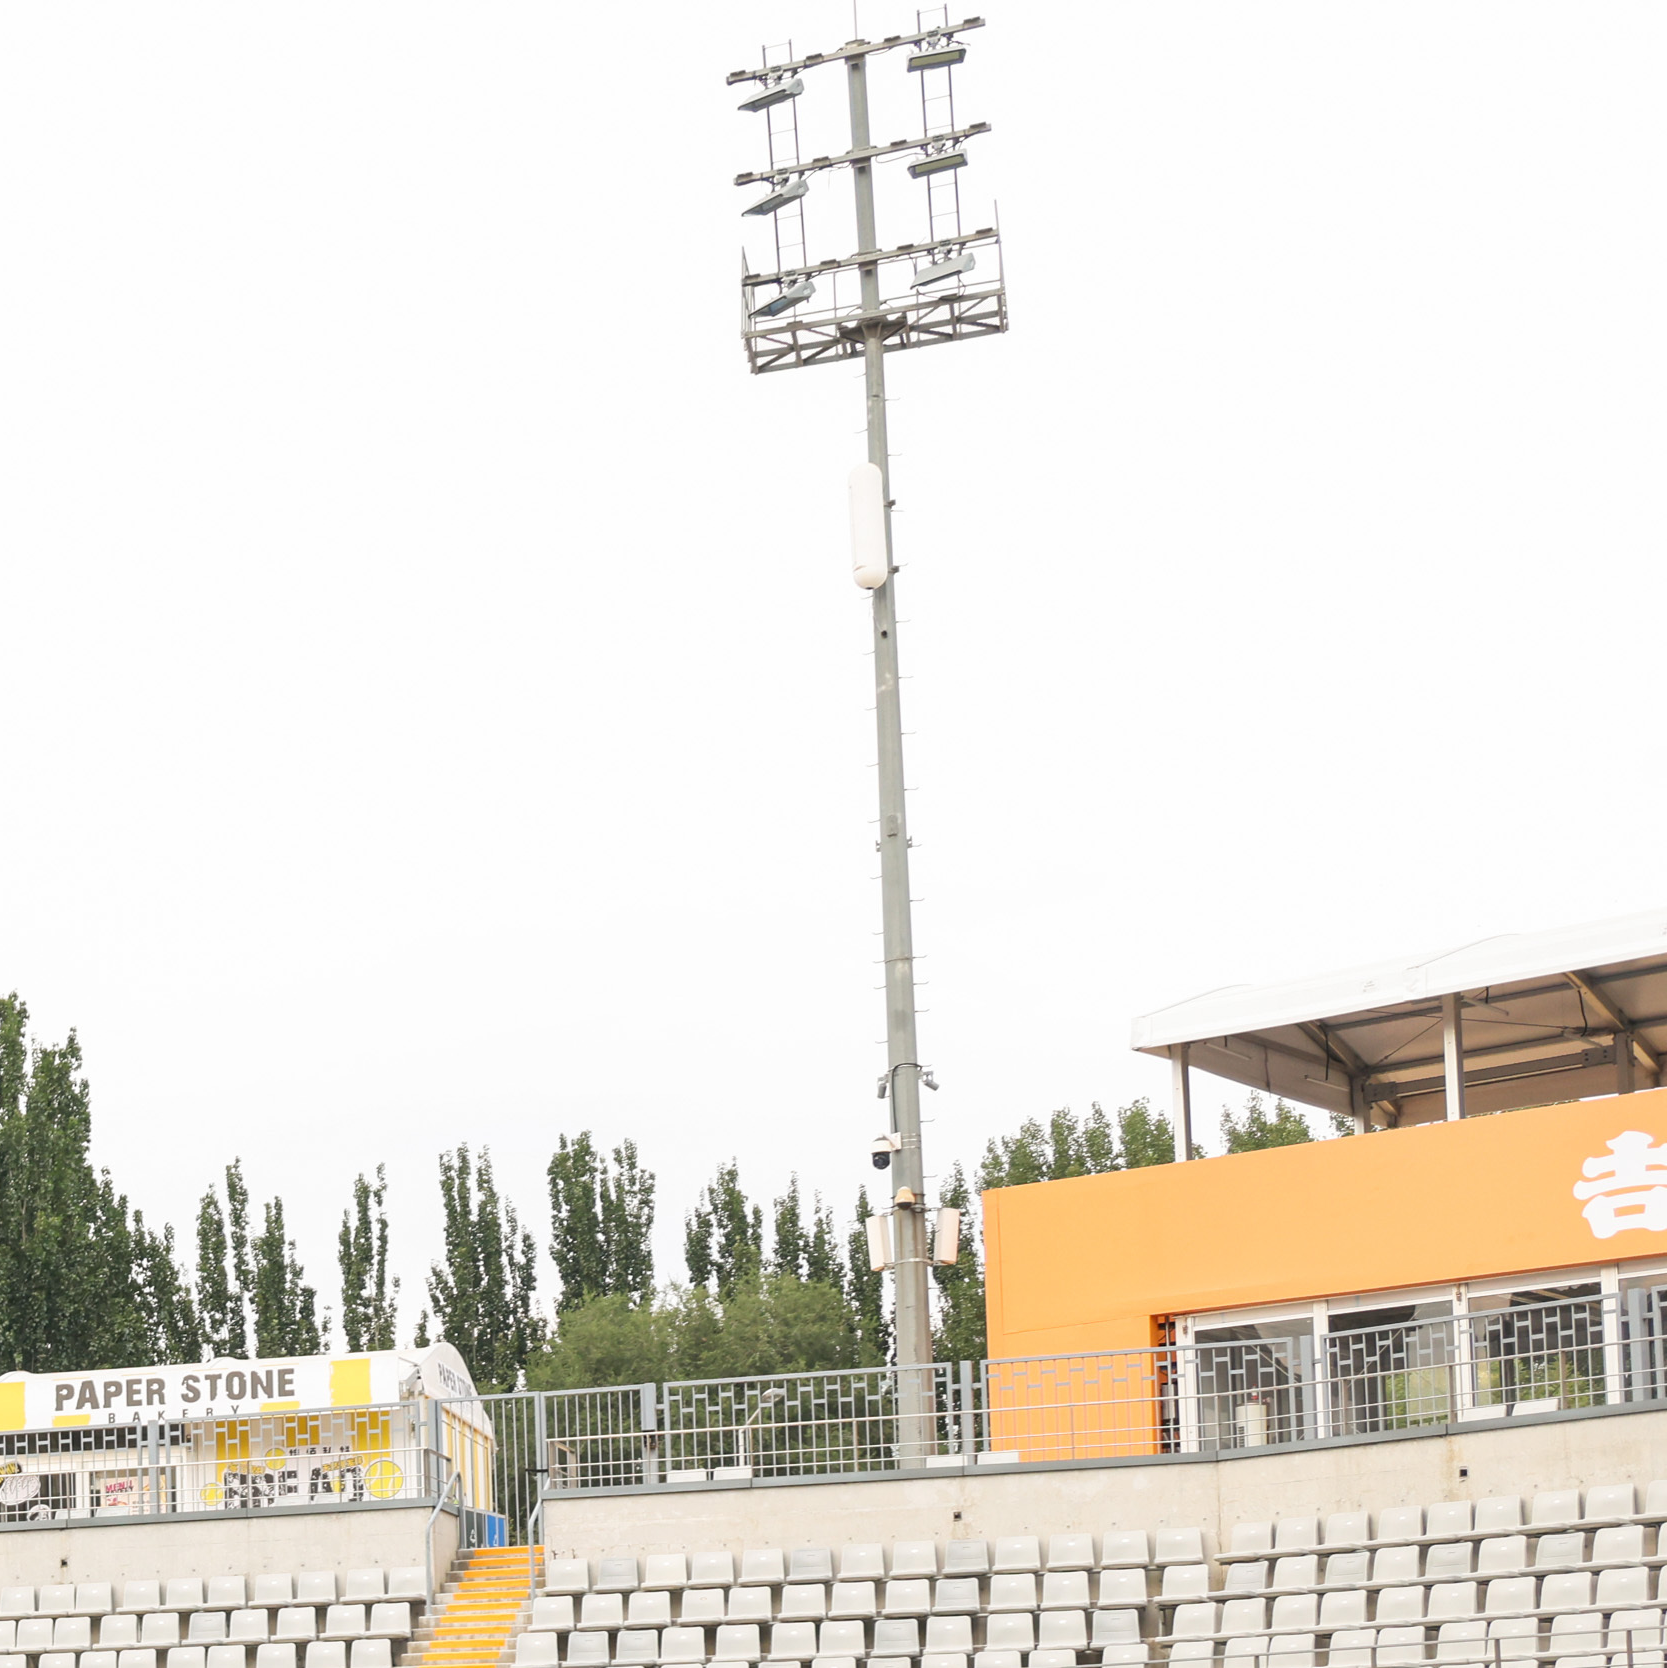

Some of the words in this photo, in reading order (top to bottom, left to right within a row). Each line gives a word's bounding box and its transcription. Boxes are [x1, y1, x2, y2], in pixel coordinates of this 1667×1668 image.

[55, 1377, 166, 1411] PAPER
[181, 1368, 295, 1403] STONE
[108, 1404, 239, 1424] BAKERY
